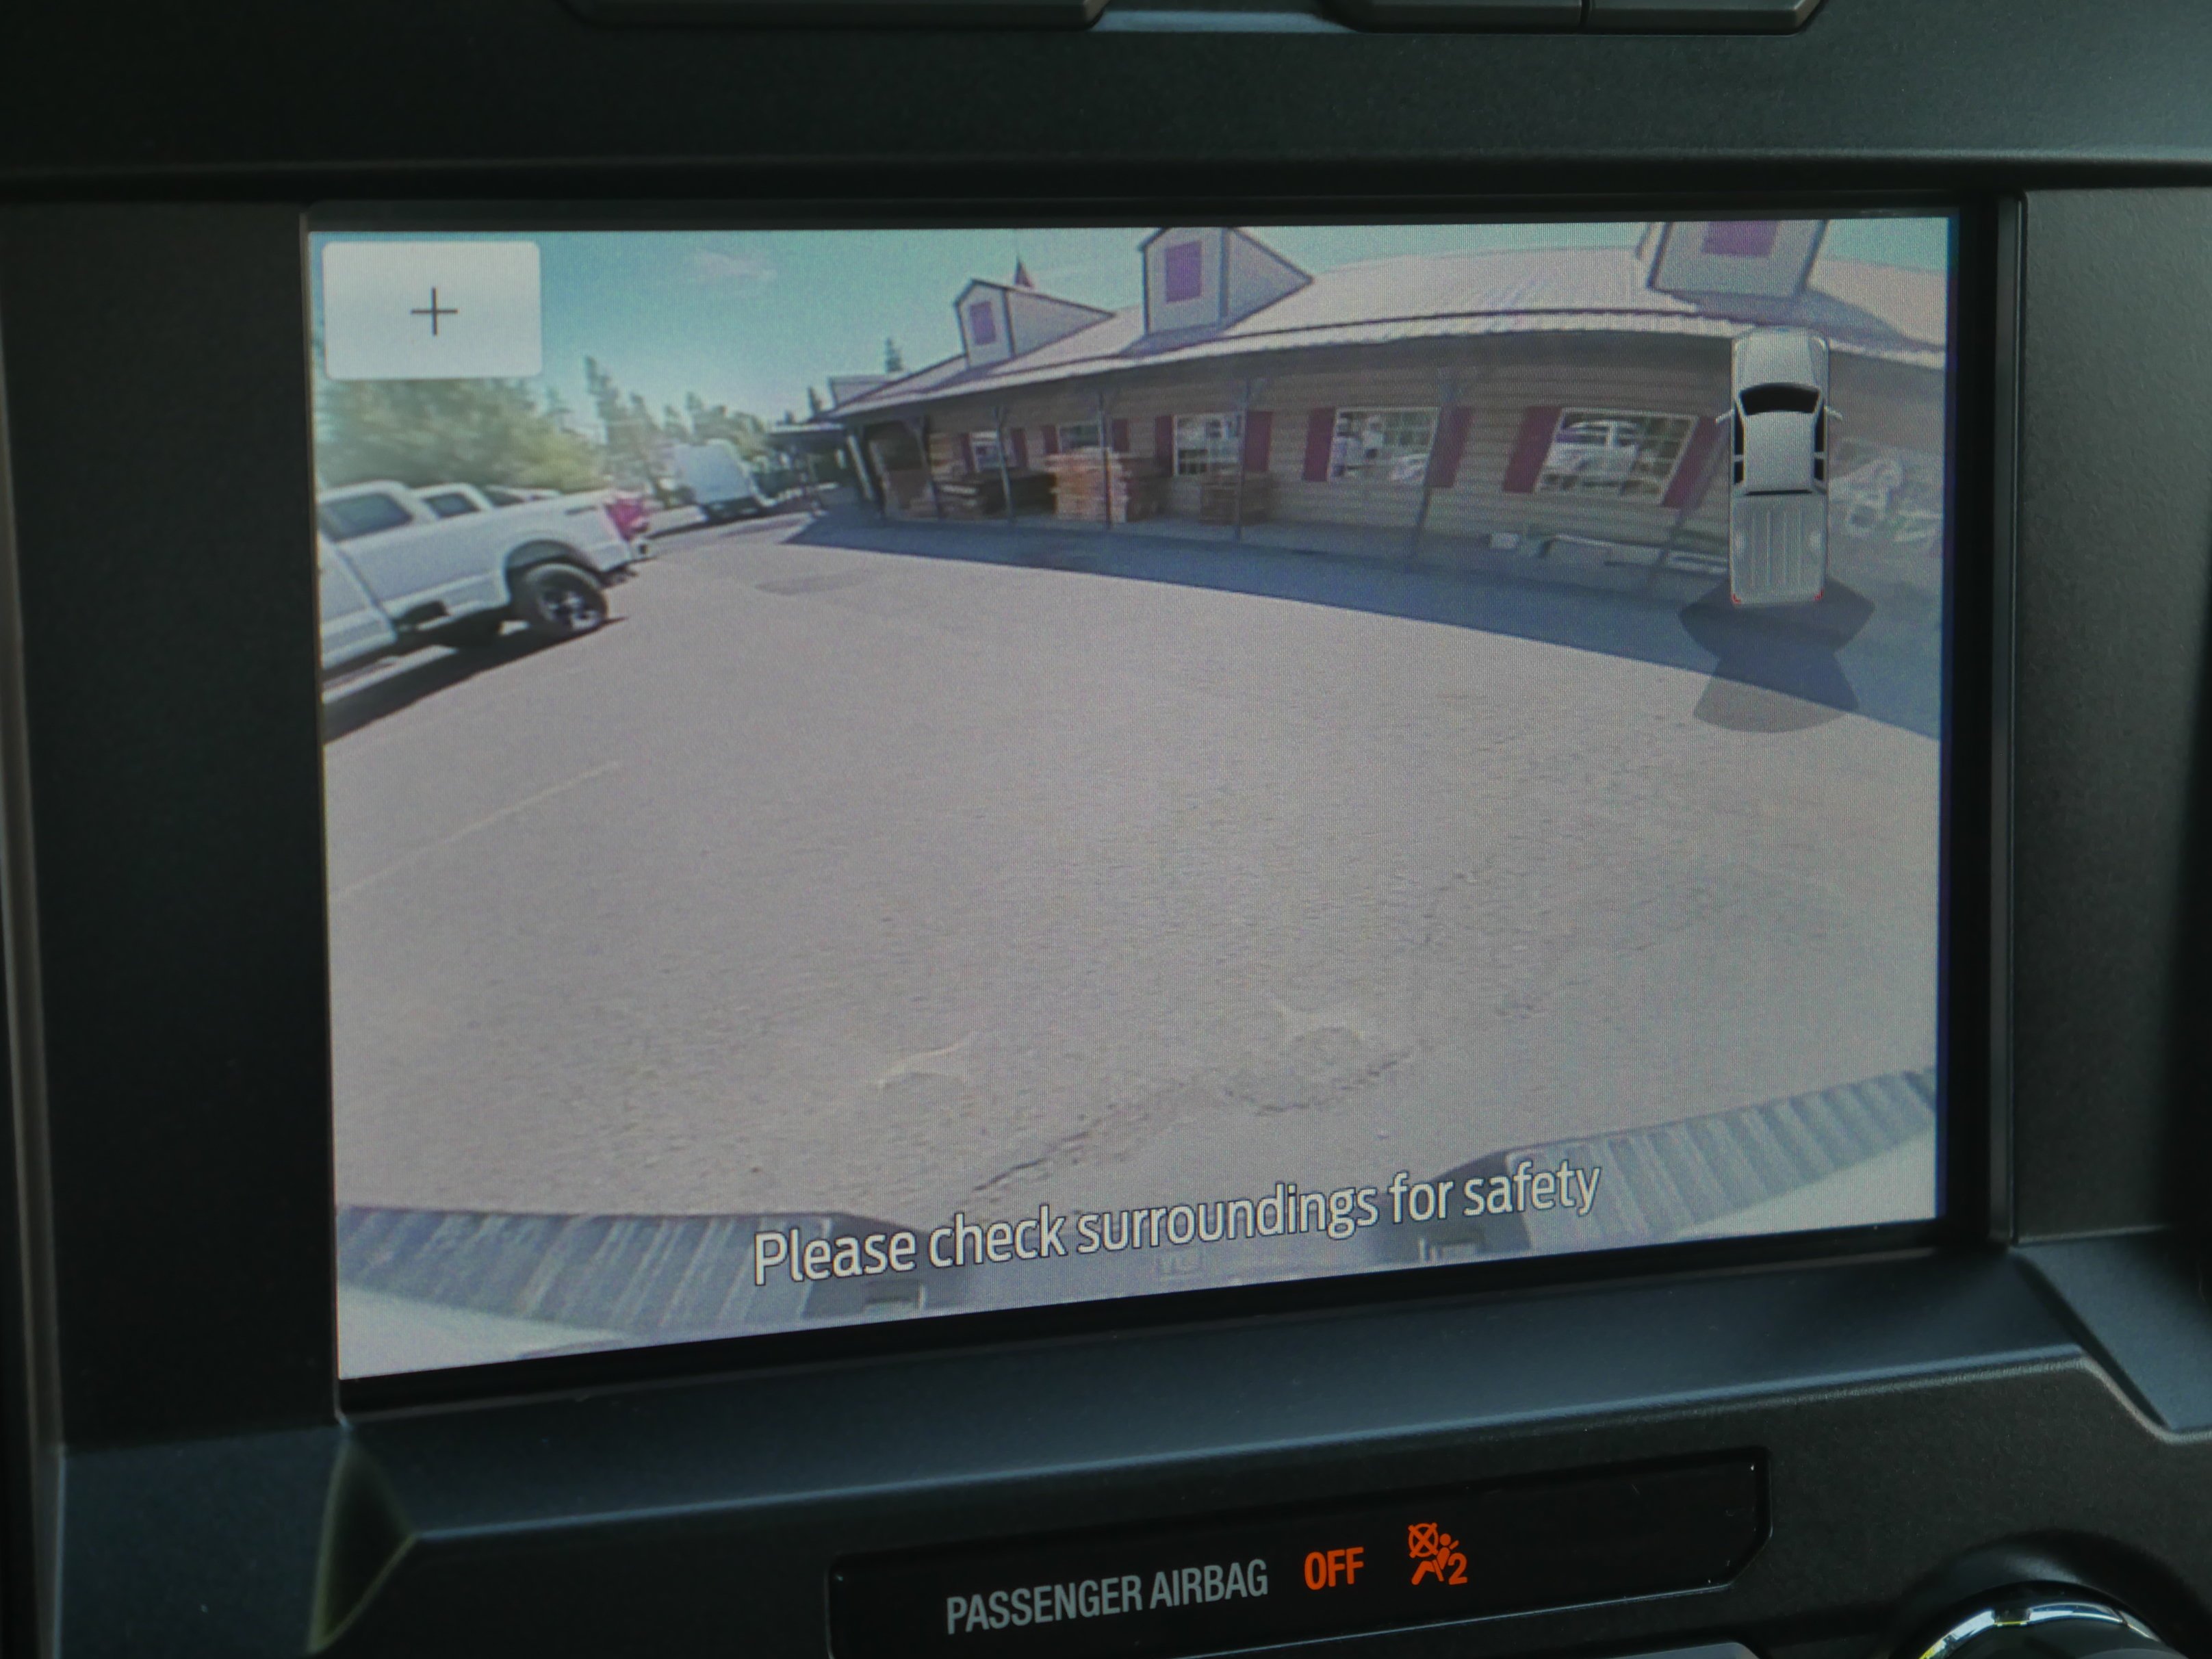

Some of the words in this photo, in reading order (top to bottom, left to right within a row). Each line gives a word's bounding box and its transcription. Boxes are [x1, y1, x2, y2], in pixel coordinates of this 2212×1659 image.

[754, 1227, 917, 1287] Please
[929, 1203, 1068, 1268] check
[1077, 1182, 1378, 1255] surroundings
[1387, 1170, 1454, 1224] for
[1463, 1159, 1602, 1218] safety
[946, 1575, 1143, 1635] PASSENGER
[1149, 1558, 1269, 1610] AIRBAG
[1304, 1547, 1364, 1591] OFF
